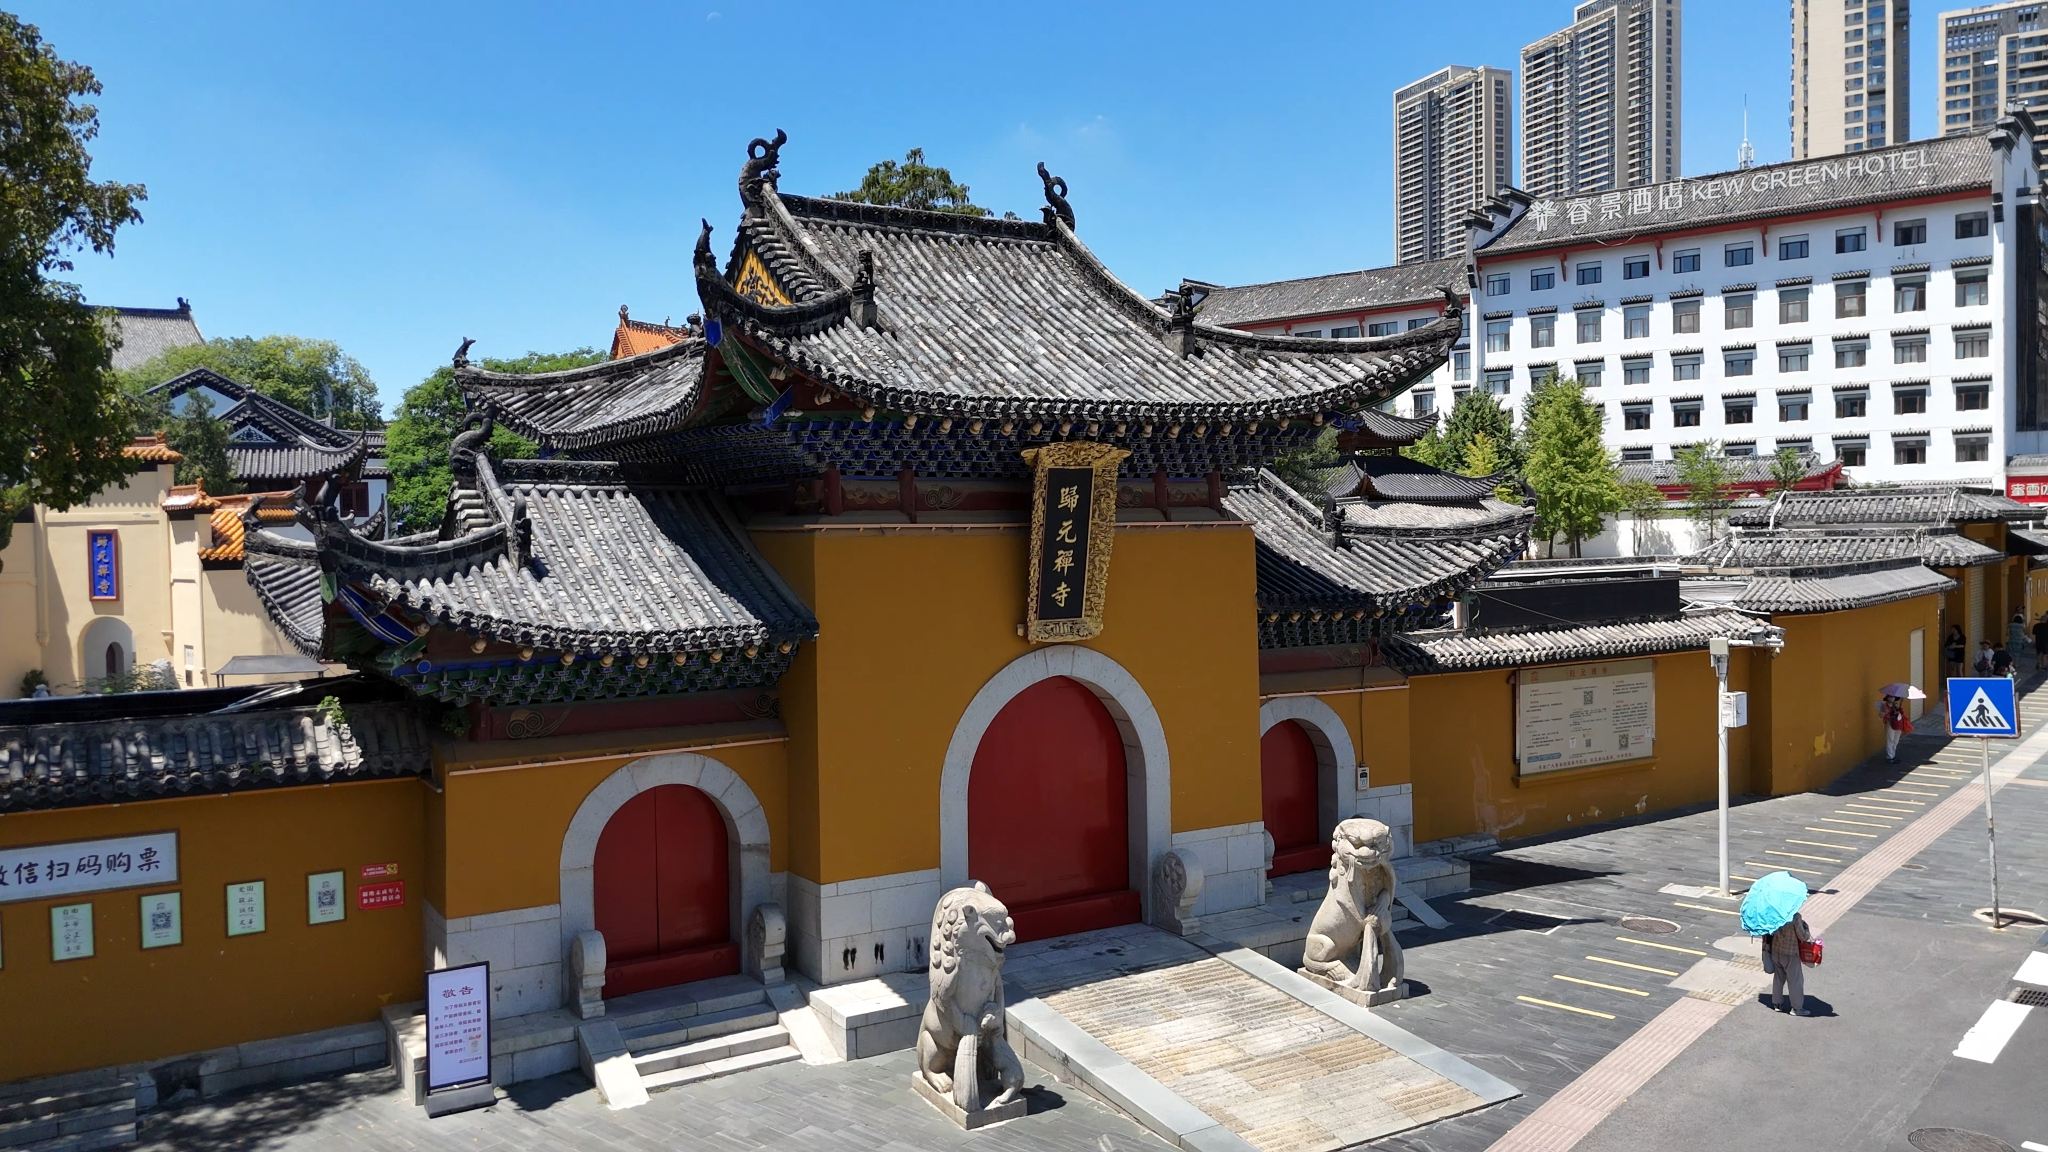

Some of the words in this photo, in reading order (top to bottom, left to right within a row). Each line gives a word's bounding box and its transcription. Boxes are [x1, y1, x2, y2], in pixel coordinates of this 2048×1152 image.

[1566, 182, 1684, 225] 睿景酒店
[1692, 177, 1744, 201] KEW
[1751, 163, 1838, 193] GREEN
[1847, 149, 1934, 179] HOTEL
[1051, 485, 1080, 608] 歸元禪寺
[442, 986, 474, 999] 敬告
